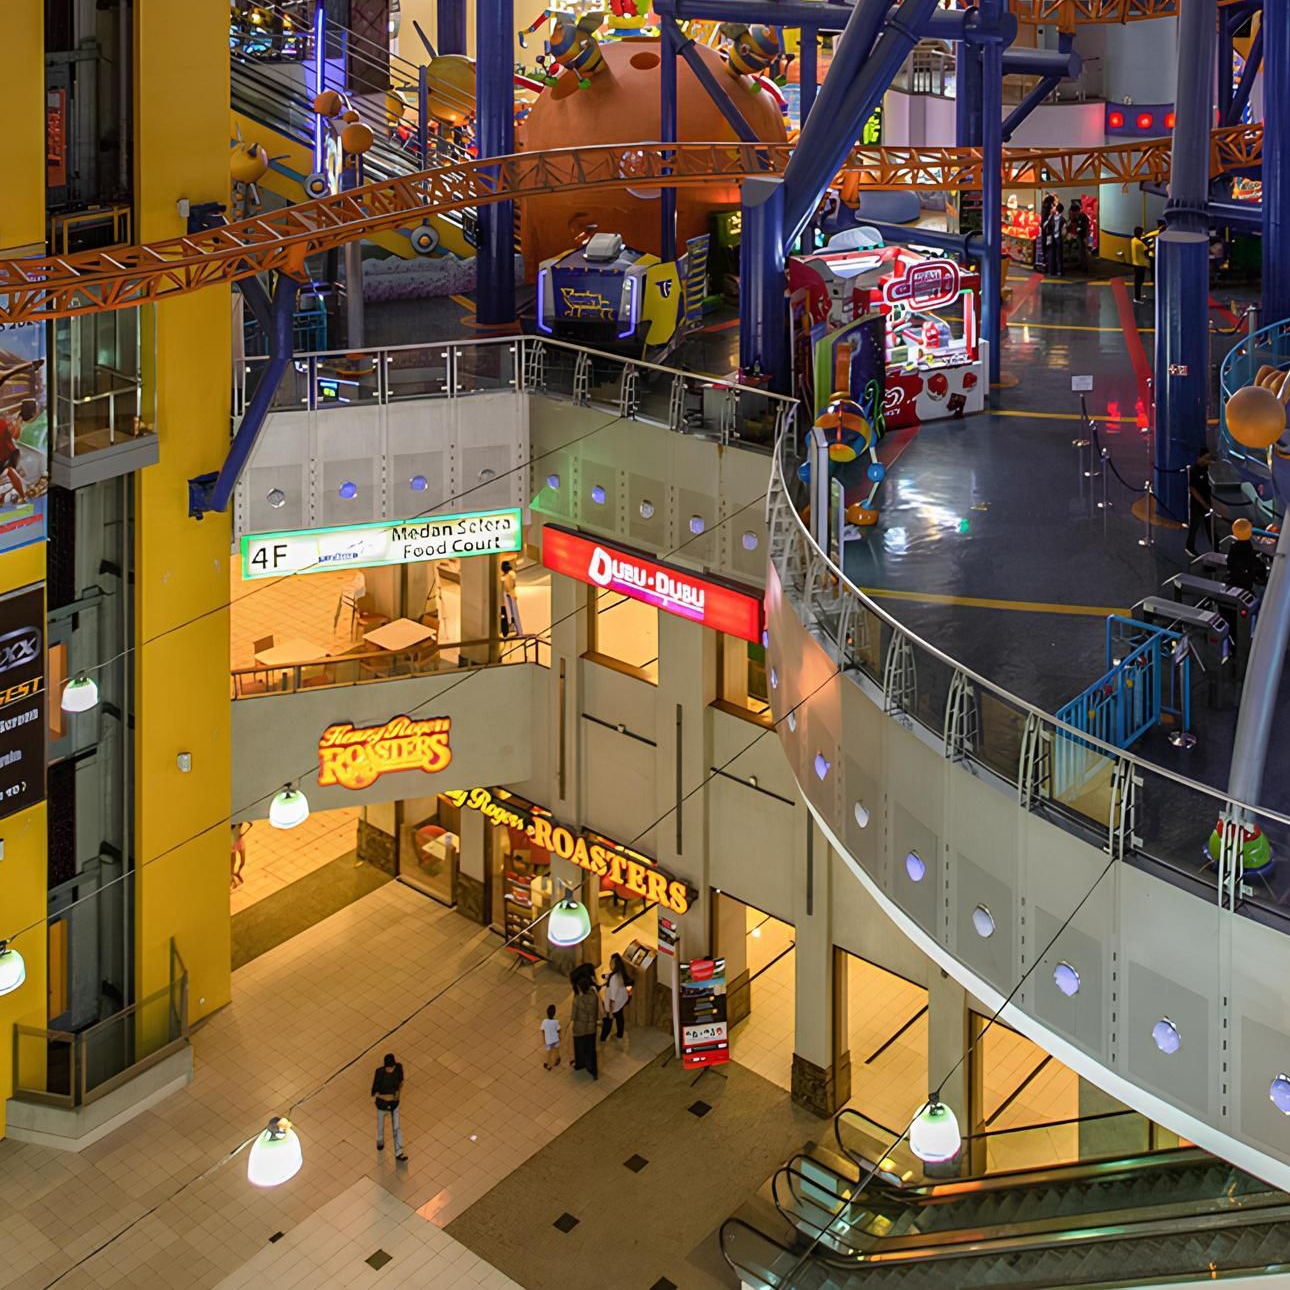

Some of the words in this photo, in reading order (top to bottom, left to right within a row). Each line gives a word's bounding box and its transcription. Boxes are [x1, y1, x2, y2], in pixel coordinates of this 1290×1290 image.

[251, 544, 288, 569] 4F
[391, 523, 452, 542] Medan
[403, 541, 447, 559] Food
[452, 536, 501, 553] Court
[318, 733, 452, 787] ROASTERS
[467, 788, 524, 830] Rogers
[529, 816, 690, 915] ROASTERS
